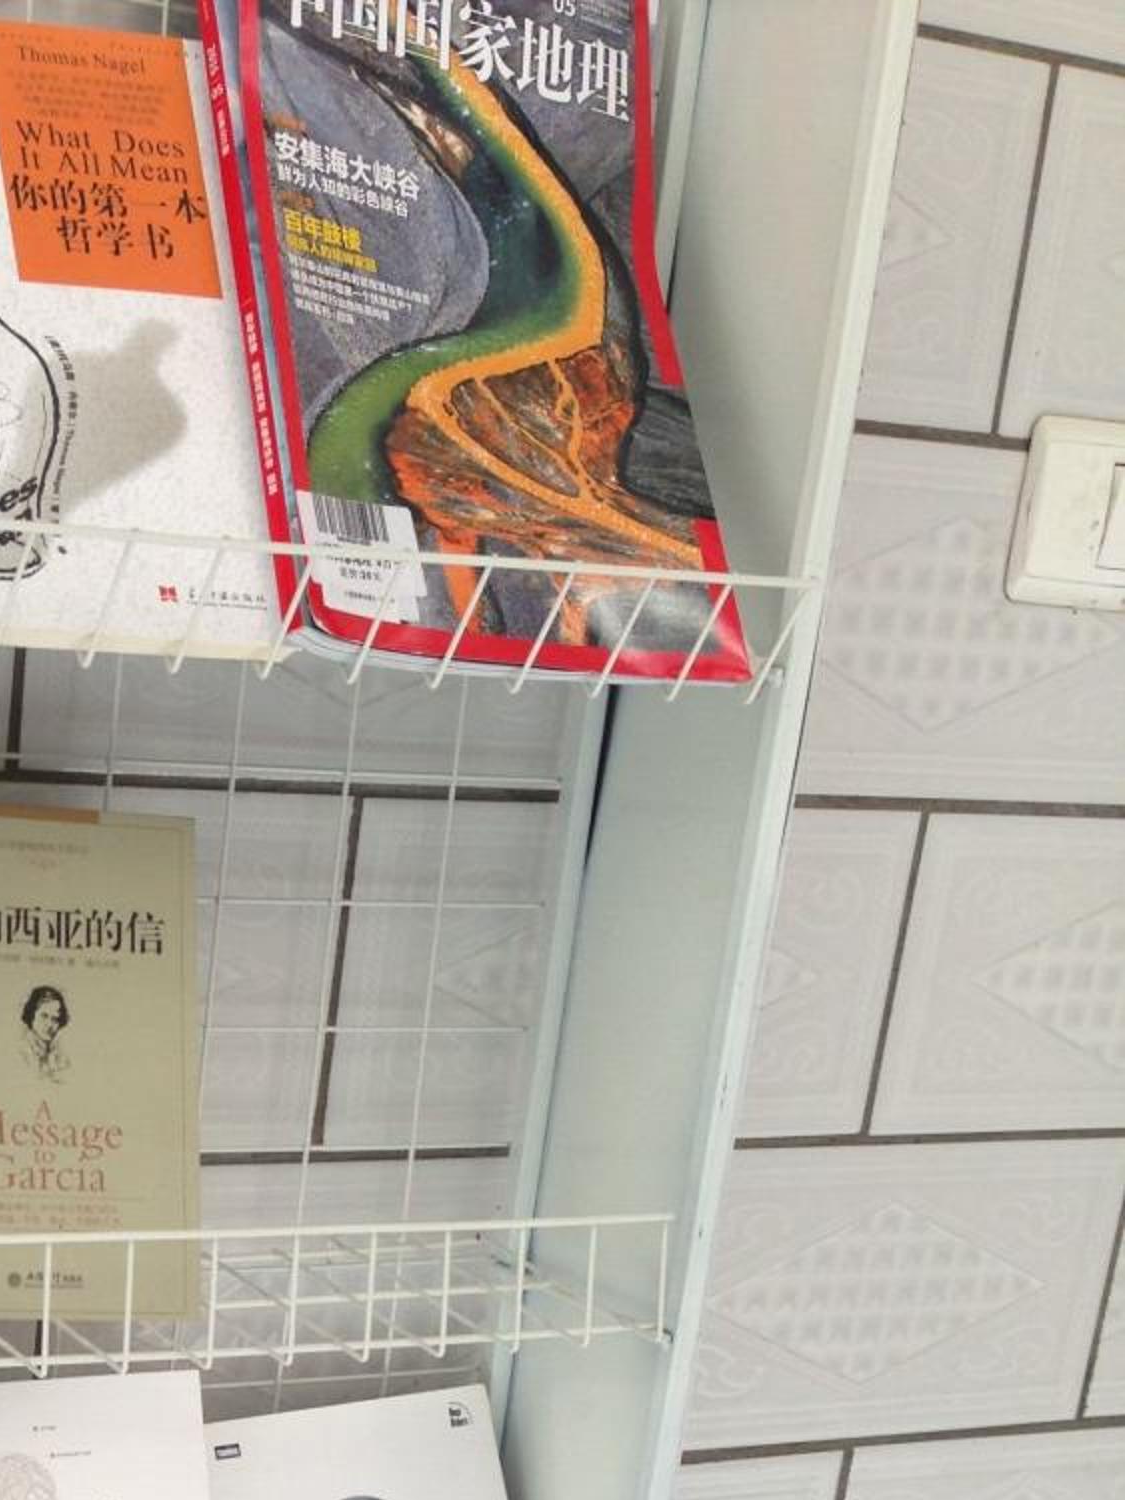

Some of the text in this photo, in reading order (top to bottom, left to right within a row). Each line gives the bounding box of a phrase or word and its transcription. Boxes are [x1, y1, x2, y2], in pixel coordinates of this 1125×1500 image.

[17, 45, 146, 77] Thomas Nagel
[15, 118, 92, 151] What
[114, 128, 185, 158] Does
[21, 146, 189, 185] It All Mean
[275, 131, 420, 201] 安集海大峡谷
[9, 173, 208, 228] 你的第一本
[56, 216, 176, 261] 哲学书
[35, 1099, 53, 1121] A
[34, 1149, 57, 1165] to
